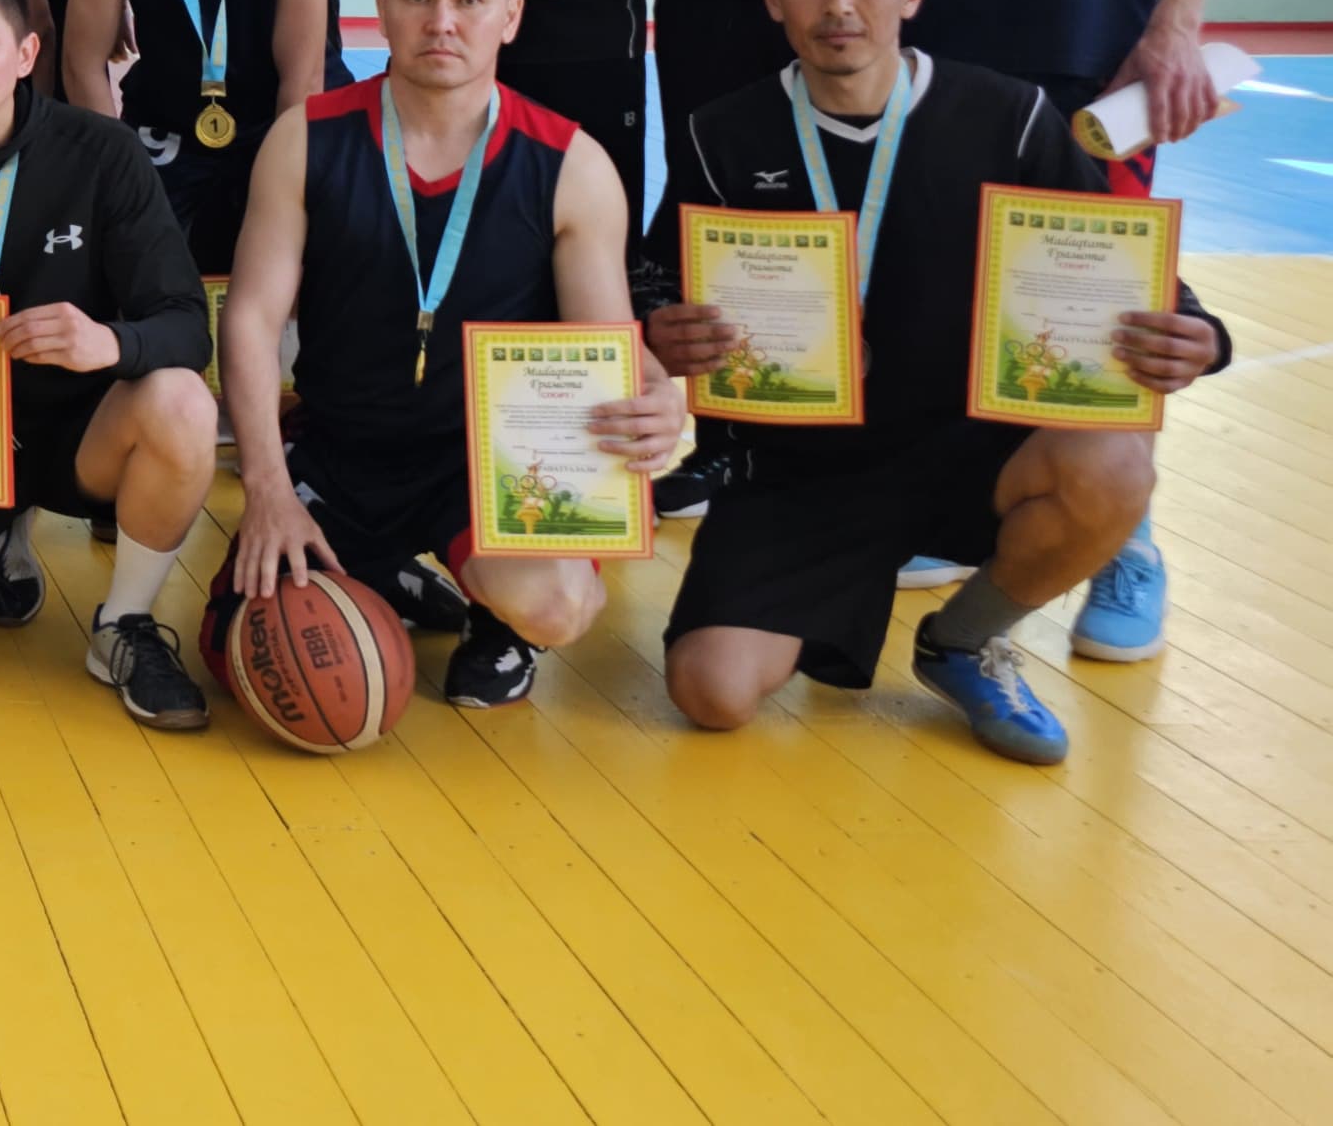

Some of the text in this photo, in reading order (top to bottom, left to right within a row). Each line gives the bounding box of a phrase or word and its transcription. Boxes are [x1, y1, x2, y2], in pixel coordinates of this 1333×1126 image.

[209, 118, 218, 133] 1
[249, 607, 305, 723] molten
[301, 625, 334, 671] FIBA
